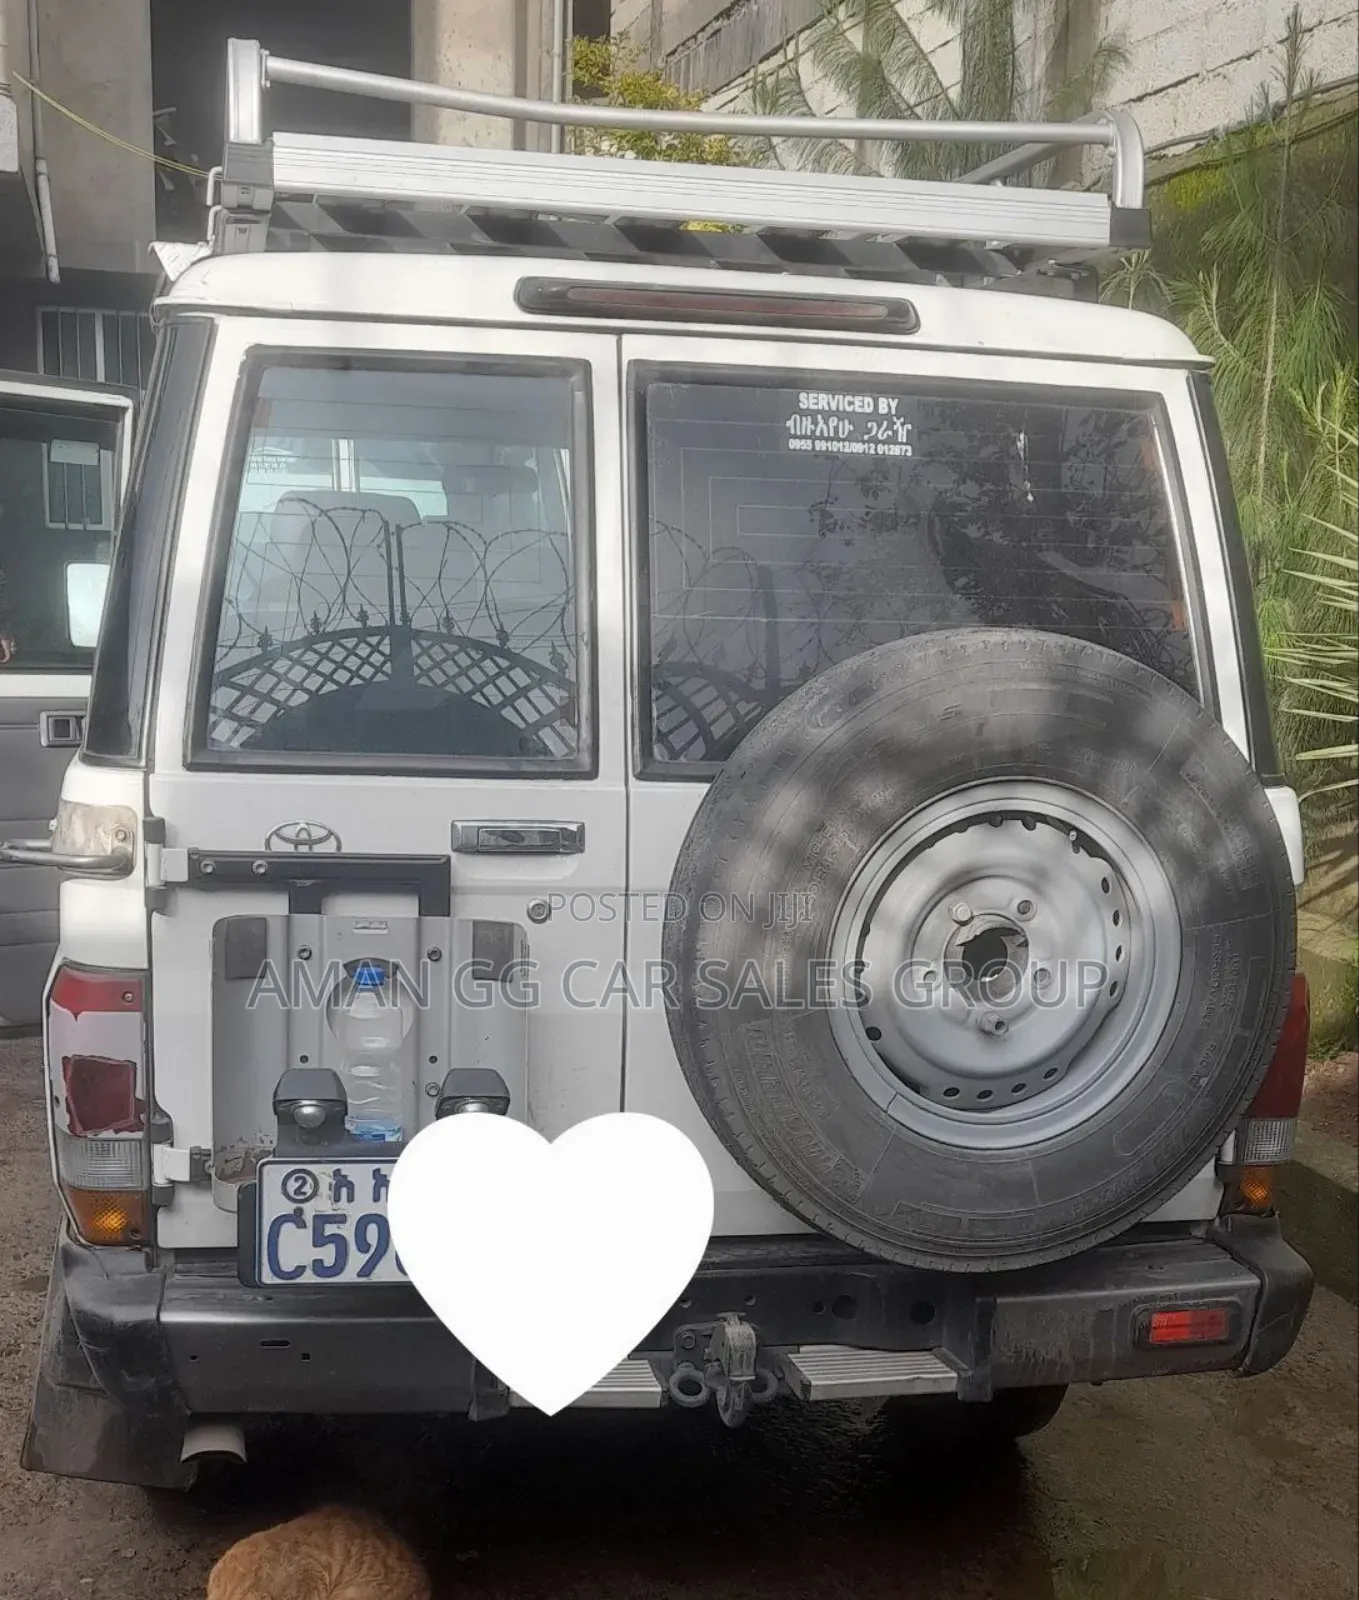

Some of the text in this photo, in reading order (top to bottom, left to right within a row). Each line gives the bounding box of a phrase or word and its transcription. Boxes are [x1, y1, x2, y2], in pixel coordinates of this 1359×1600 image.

[798, 392, 899, 415] SERVICED BY
[266, 1211, 408, 1281] C59
